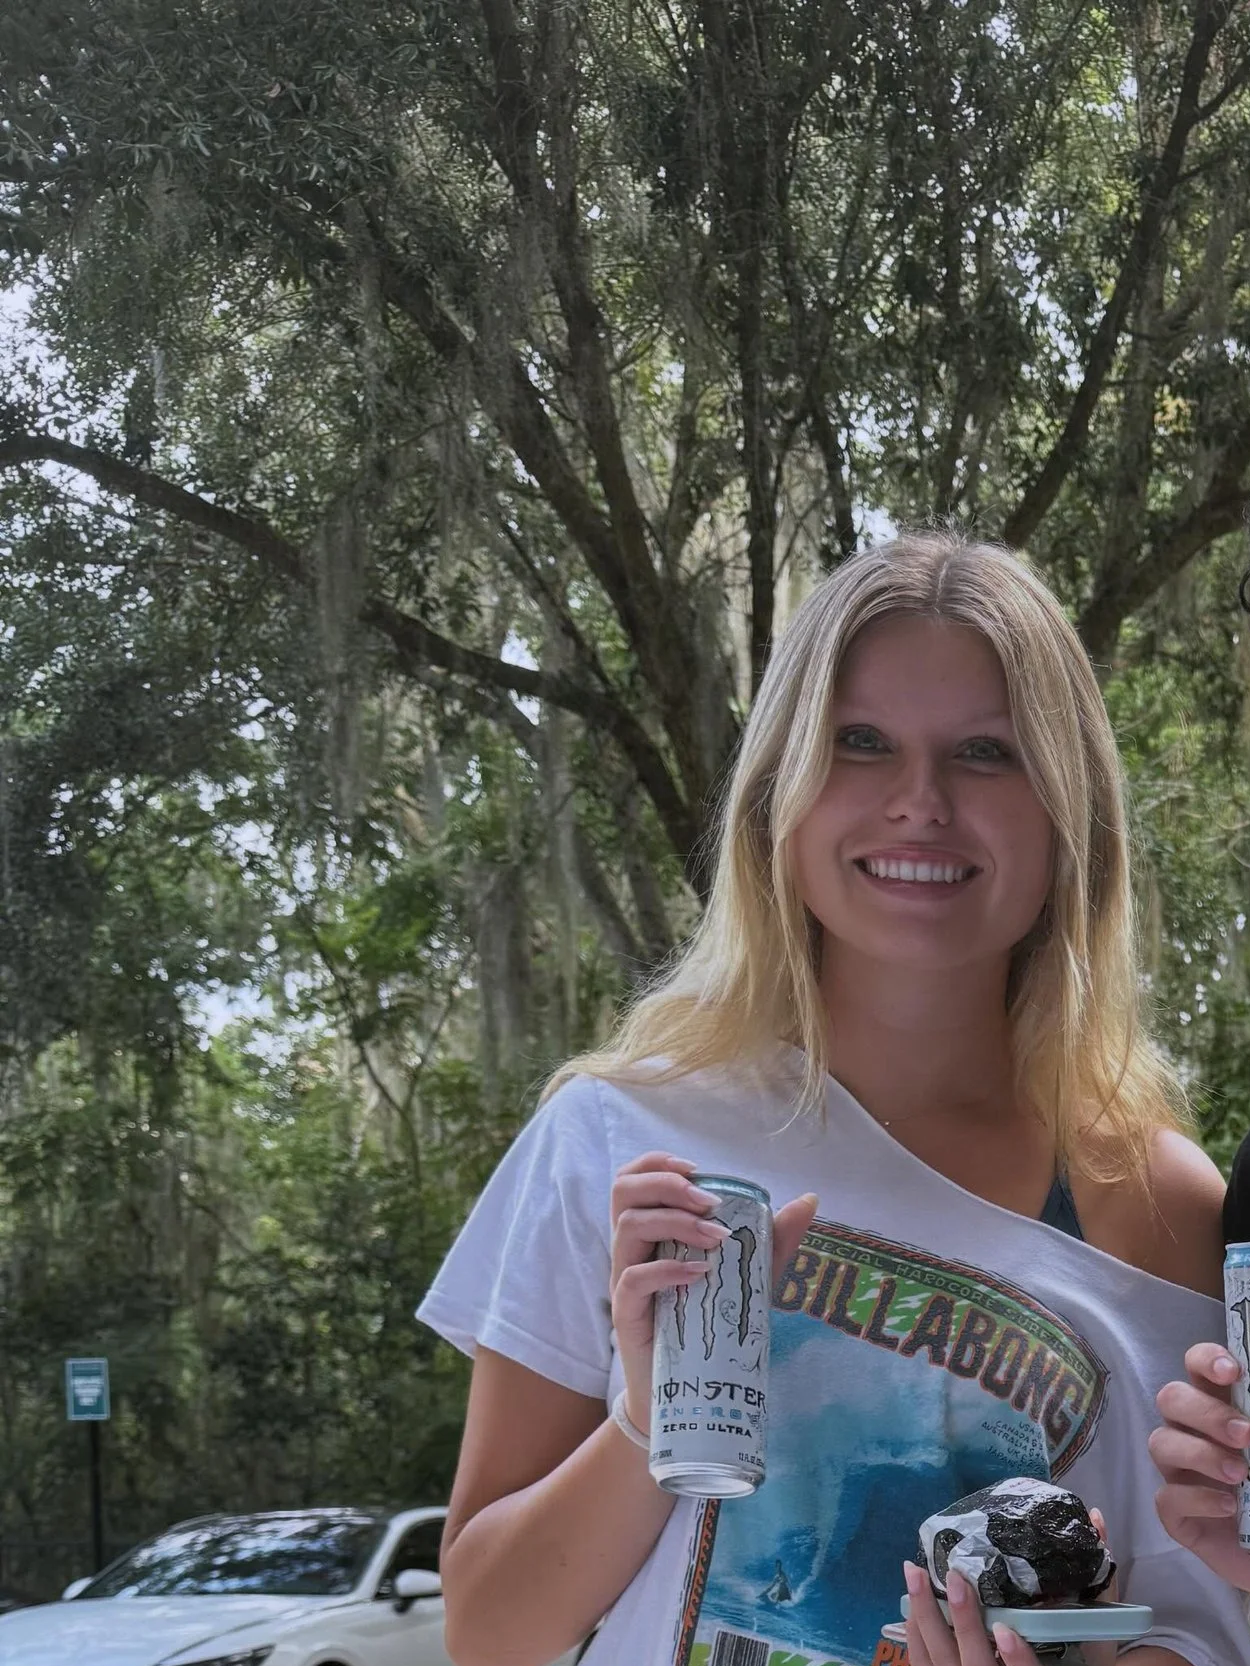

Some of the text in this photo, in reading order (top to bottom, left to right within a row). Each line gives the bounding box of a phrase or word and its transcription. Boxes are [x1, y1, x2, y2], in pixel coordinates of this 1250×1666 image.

[801, 1235, 884, 1268] SPECIAL
[895, 1264, 995, 1309] HARDCORE
[769, 1249, 1087, 1448] BILLABONG
[663, 1422, 752, 1438] ZERO ULTRA
[982, 1421, 1027, 1451] AUSTRALIA
[995, 1420, 1030, 1443] CANADA
